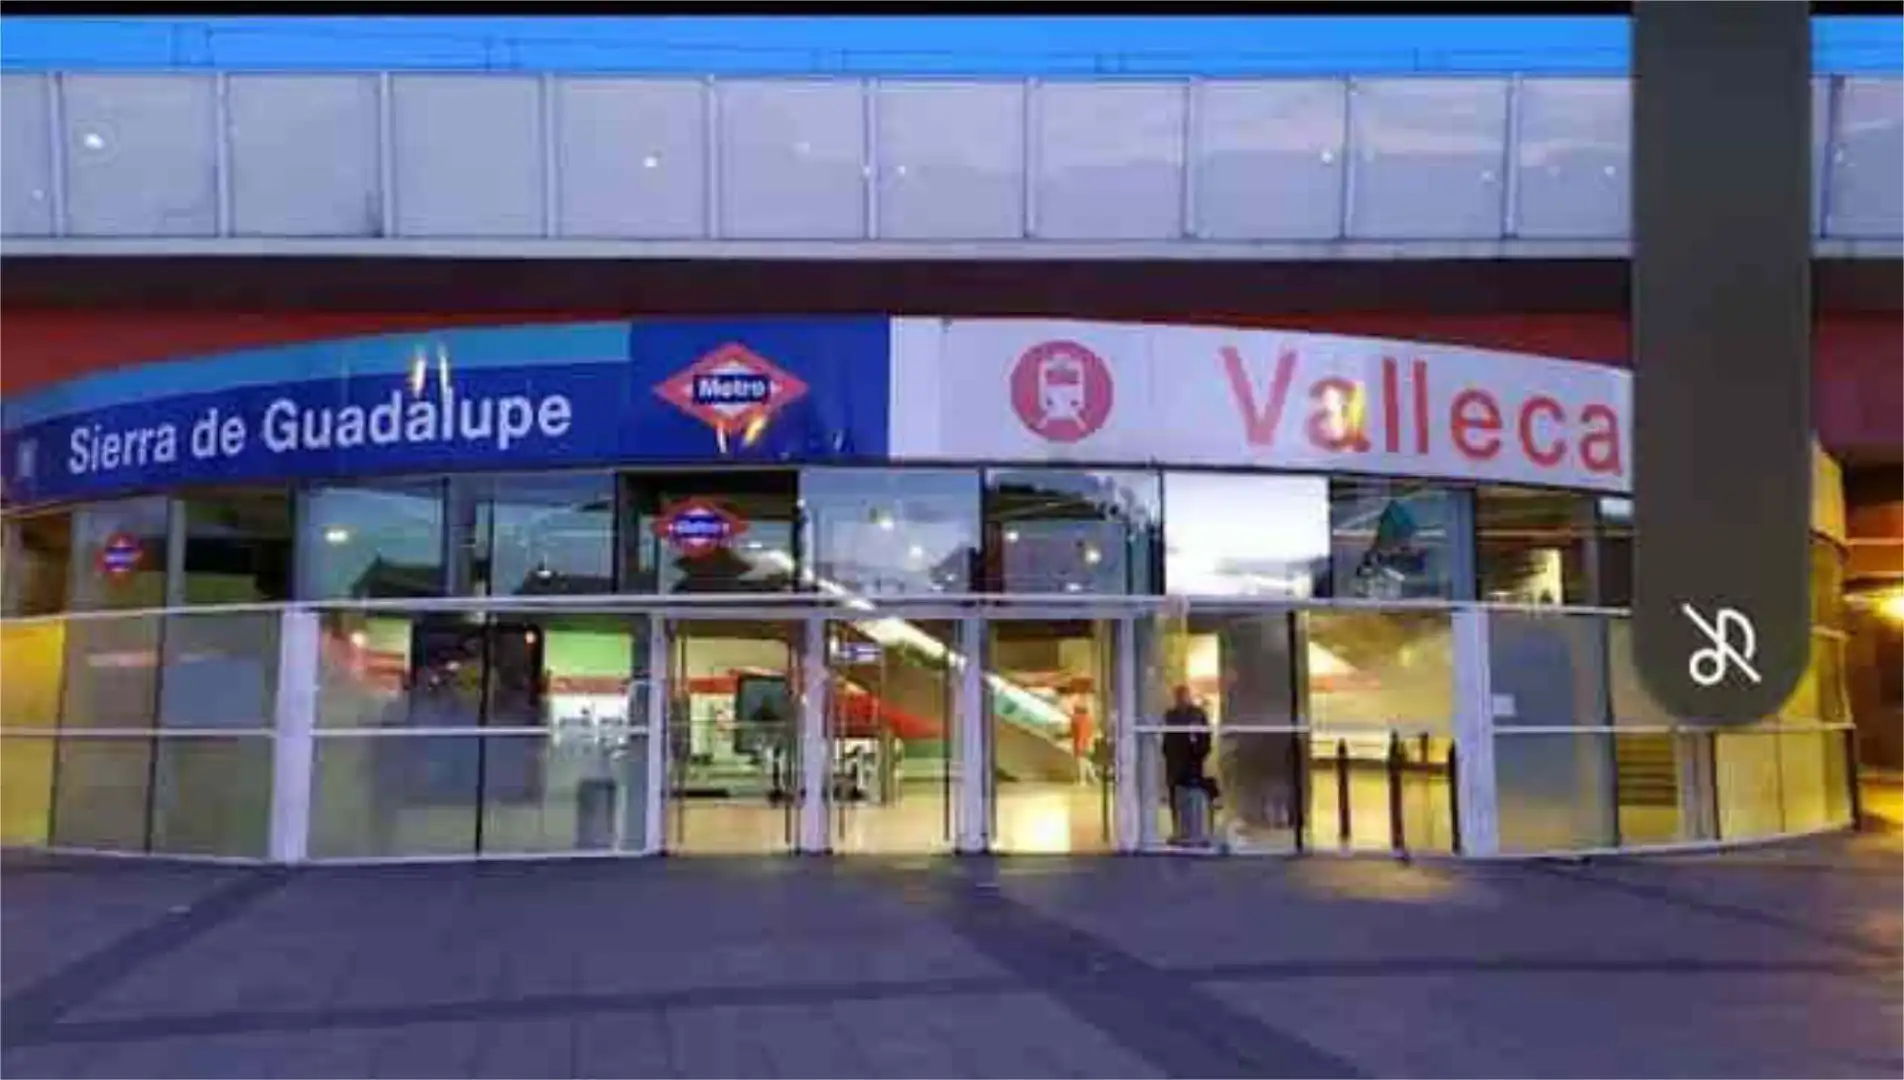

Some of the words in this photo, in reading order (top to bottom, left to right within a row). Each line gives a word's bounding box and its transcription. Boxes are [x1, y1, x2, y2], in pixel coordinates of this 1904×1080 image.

[697, 378, 767, 400] Metro
[1220, 346, 1622, 476] Valleca
[68, 425, 177, 475] Sierra
[192, 408, 246, 458] de
[263, 392, 572, 451] Guadalupe
